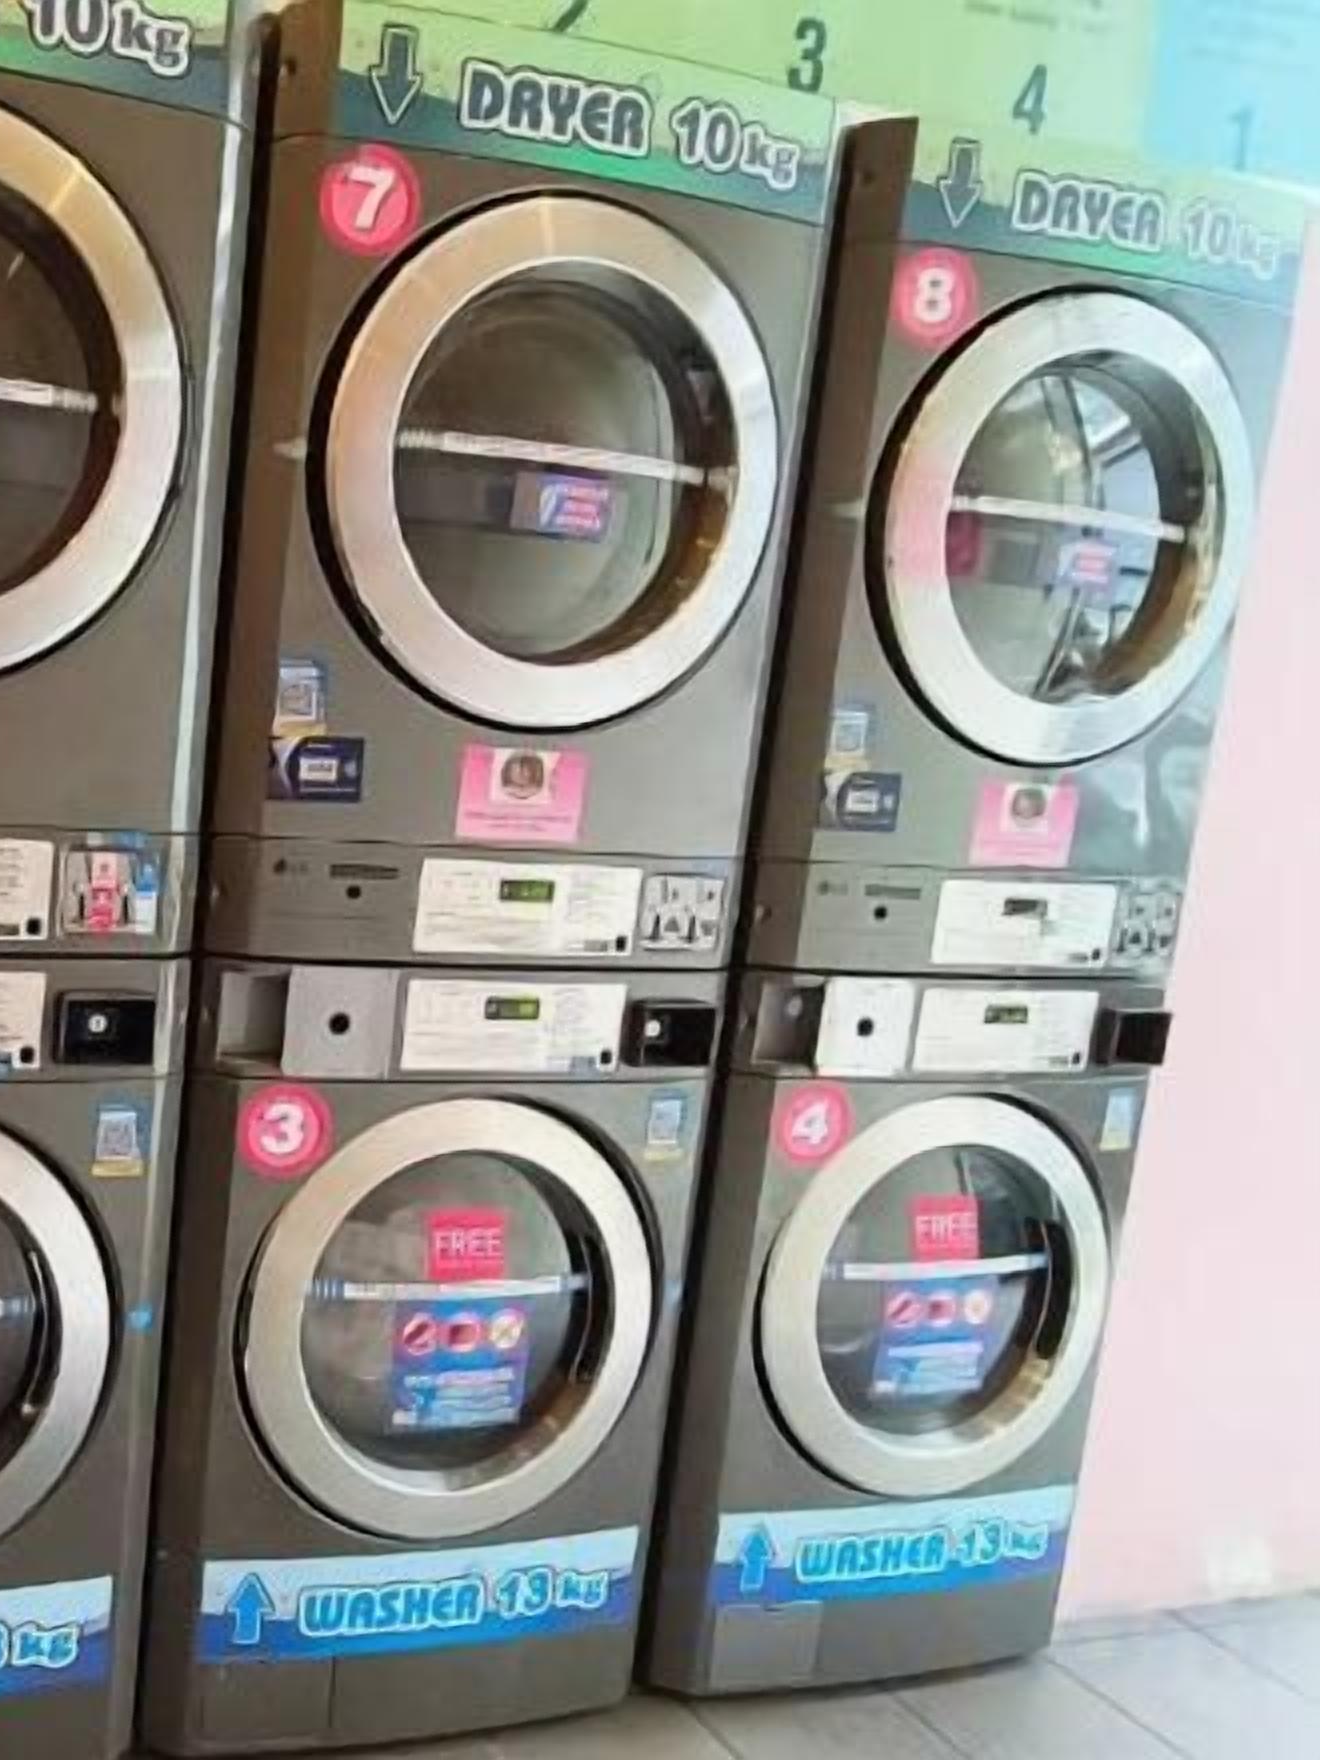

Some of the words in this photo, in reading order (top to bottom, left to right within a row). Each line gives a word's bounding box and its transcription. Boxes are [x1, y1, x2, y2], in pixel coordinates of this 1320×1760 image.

[787, 17, 827, 93] 3
[465, 65, 647, 154] DRYER
[1013, 64, 1047, 135] 4
[349, 164, 395, 230] 7
[1016, 176, 1162, 248] DRYER
[914, 267, 952, 323] 8
[260, 1102, 304, 1154] 3
[791, 1100, 829, 1144] 4
[434, 1227, 503, 1257] FREE
[915, 1212, 978, 1241] FREE
[798, 1531, 947, 1580] WASHER
[302, 1580, 483, 1632] WASHER
